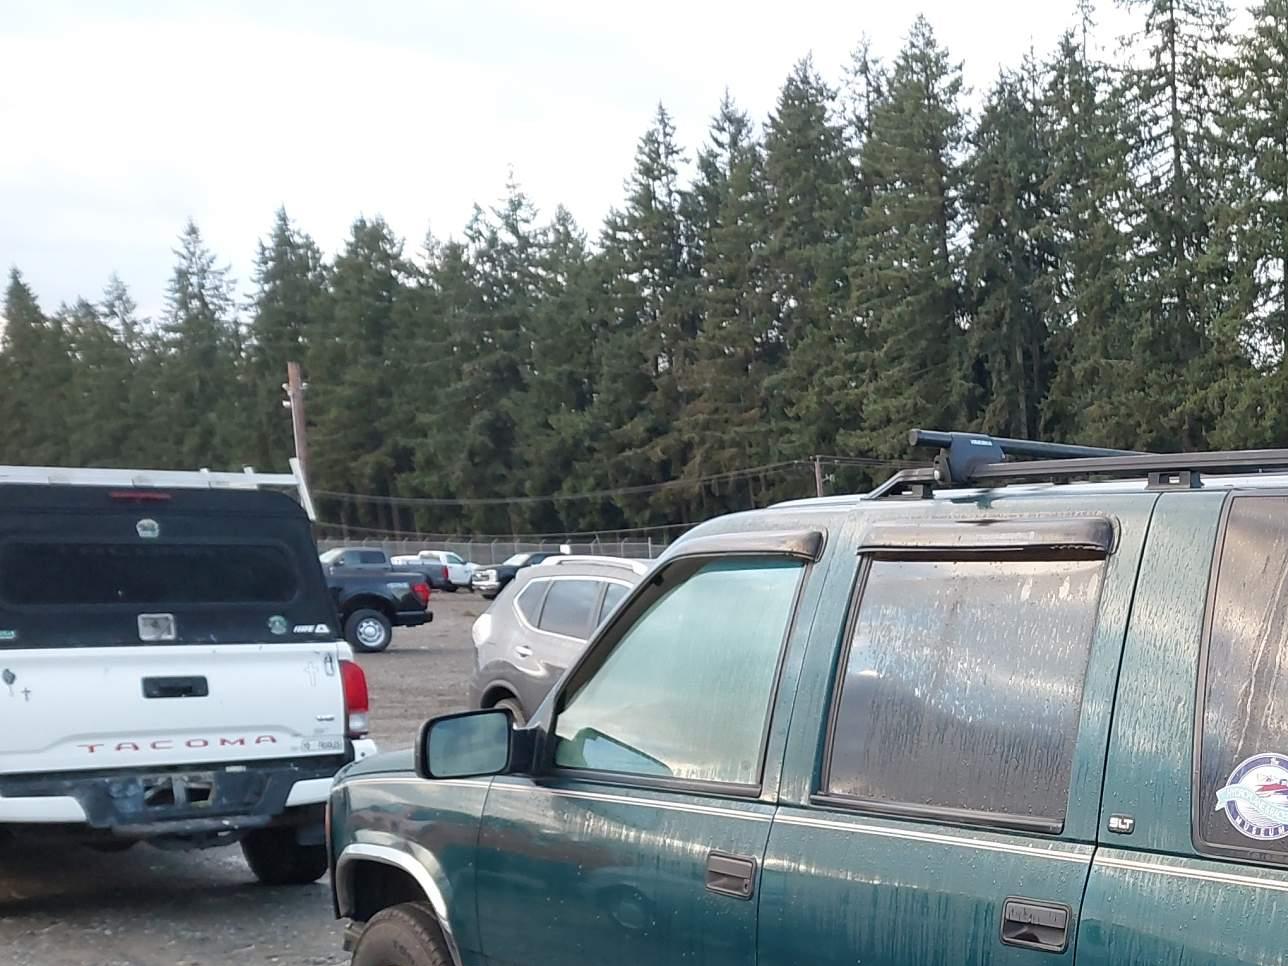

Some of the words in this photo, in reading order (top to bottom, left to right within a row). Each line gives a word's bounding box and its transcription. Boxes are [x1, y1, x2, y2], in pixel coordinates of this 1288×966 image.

[77, 735, 277, 753] TACOMA
[1109, 816, 1134, 830] SLT
[1235, 815, 1286, 837] MUSEUM
